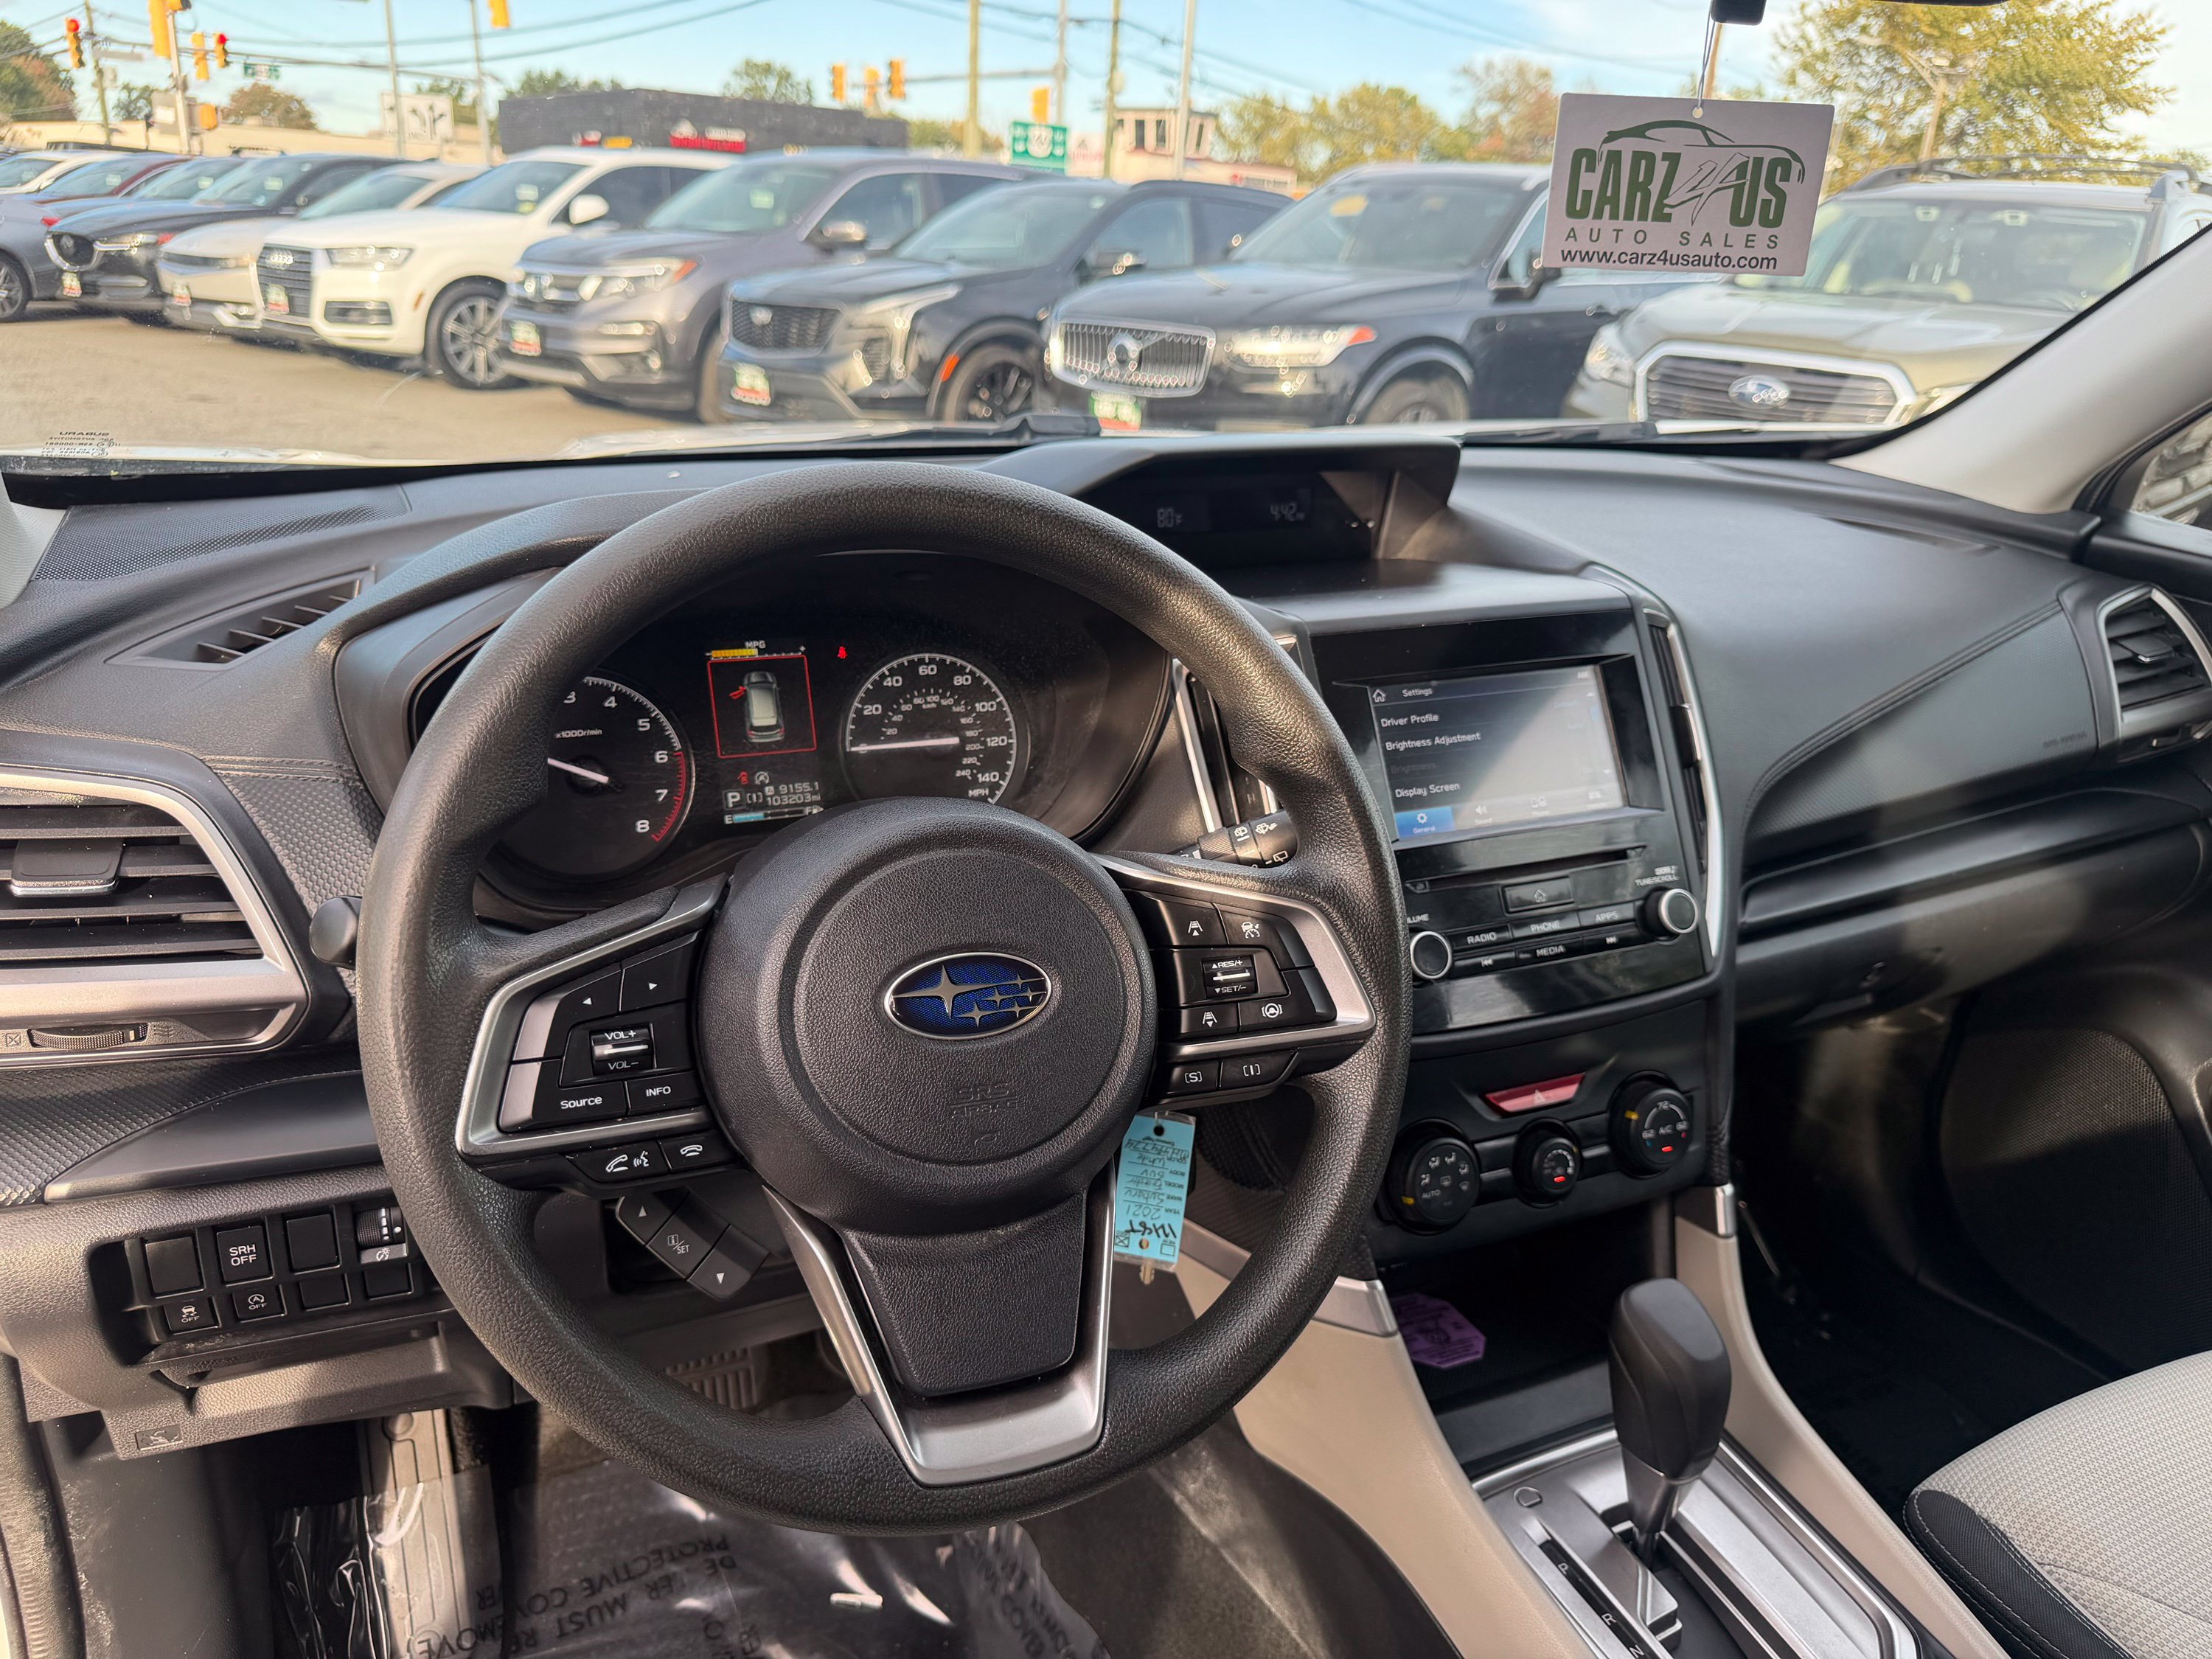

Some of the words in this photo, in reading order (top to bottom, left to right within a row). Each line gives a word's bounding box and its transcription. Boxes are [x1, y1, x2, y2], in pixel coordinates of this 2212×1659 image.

[1565, 227, 1647, 245] AUTO
[1679, 231, 1778, 249] SALES
[1560, 247, 1778, 271] www.carz4usauto.com
[745, 640, 765, 650] MPG
[918, 664, 937, 676] 60
[883, 676, 902, 687] 40
[953, 675, 972, 686] 80
[563, 691, 577, 703] 3
[1402, 686, 1433, 698] Settings
[602, 696, 617, 709] 4
[975, 701, 997, 712] 100
[863, 704, 883, 715] 20
[891, 714, 903, 722] 40
[1380, 716, 1408, 728] Driver
[1410, 713, 1439, 725] Profile
[637, 718, 650, 731] 5
[886, 728, 897, 736] 20
[986, 735, 1007, 747] 120
[1385, 737, 1432, 751] Brightness
[1433, 731, 1482, 746] Adjustment
[654, 751, 668, 764] 6
[977, 771, 1000, 783] 140
[655, 789, 668, 801] 7
[968, 787, 989, 798] MPH
[1395, 787, 1427, 799] Display
[1429, 782, 1460, 794] Screen
[728, 792, 741, 808] P
[635, 819, 650, 833] 8
[724, 815, 733, 825] E
[1595, 911, 1620, 922] APPS
[1530, 920, 1561, 933] PHONE
[1467, 932, 1498, 945] RADIO
[1536, 945, 1565, 957] MEDIA
[646, 1085, 671, 1097] INFO
[560, 1096, 602, 1109] Source
[1140, 1169, 1165, 1180] SUV
[1422, 1188, 1441, 1200] AUTO
[1126, 1204, 1161, 1220] 2021
[229, 1244, 257, 1256] SRH
[231, 1253, 257, 1266] OFF
[248, 1302, 267, 1310] OFF
[580, 1533, 731, 1598] PROTECTIVE
[1558, 1562, 1570, 1576] P
[556, 1592, 627, 1638] MUST
[1601, 1613, 1617, 1626] R
[1630, 1644, 1645, 1658] N
